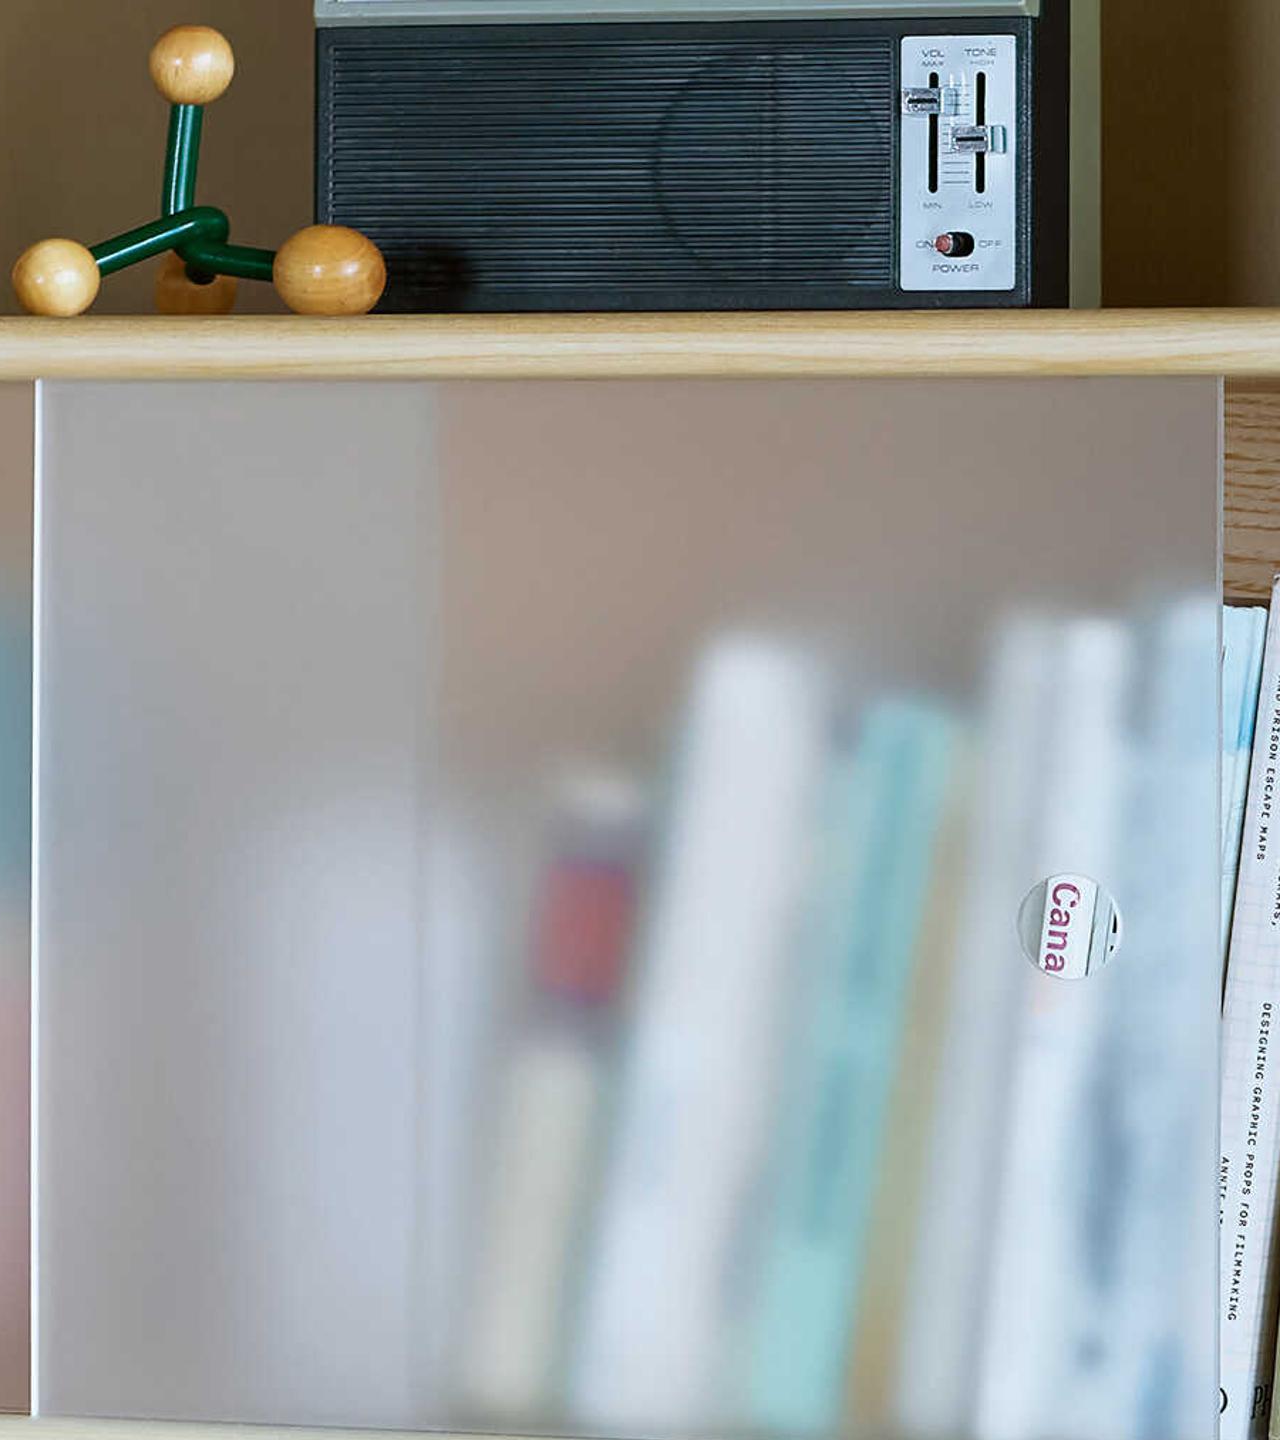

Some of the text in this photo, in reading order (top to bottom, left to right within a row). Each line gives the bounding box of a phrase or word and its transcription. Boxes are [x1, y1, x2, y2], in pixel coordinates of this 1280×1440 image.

[921, 49, 945, 58] VOL
[964, 47, 997, 57] TONE
[932, 264, 979, 273] POWER
[1261, 767, 1275, 819] ESCAPE
[1256, 825, 1268, 860] MAPS
[1044, 882, 1081, 973] Cana
[1227, 1002, 1272, 1321] DESIGNING GRAPHIC PROPS FOR FILMMAKING
